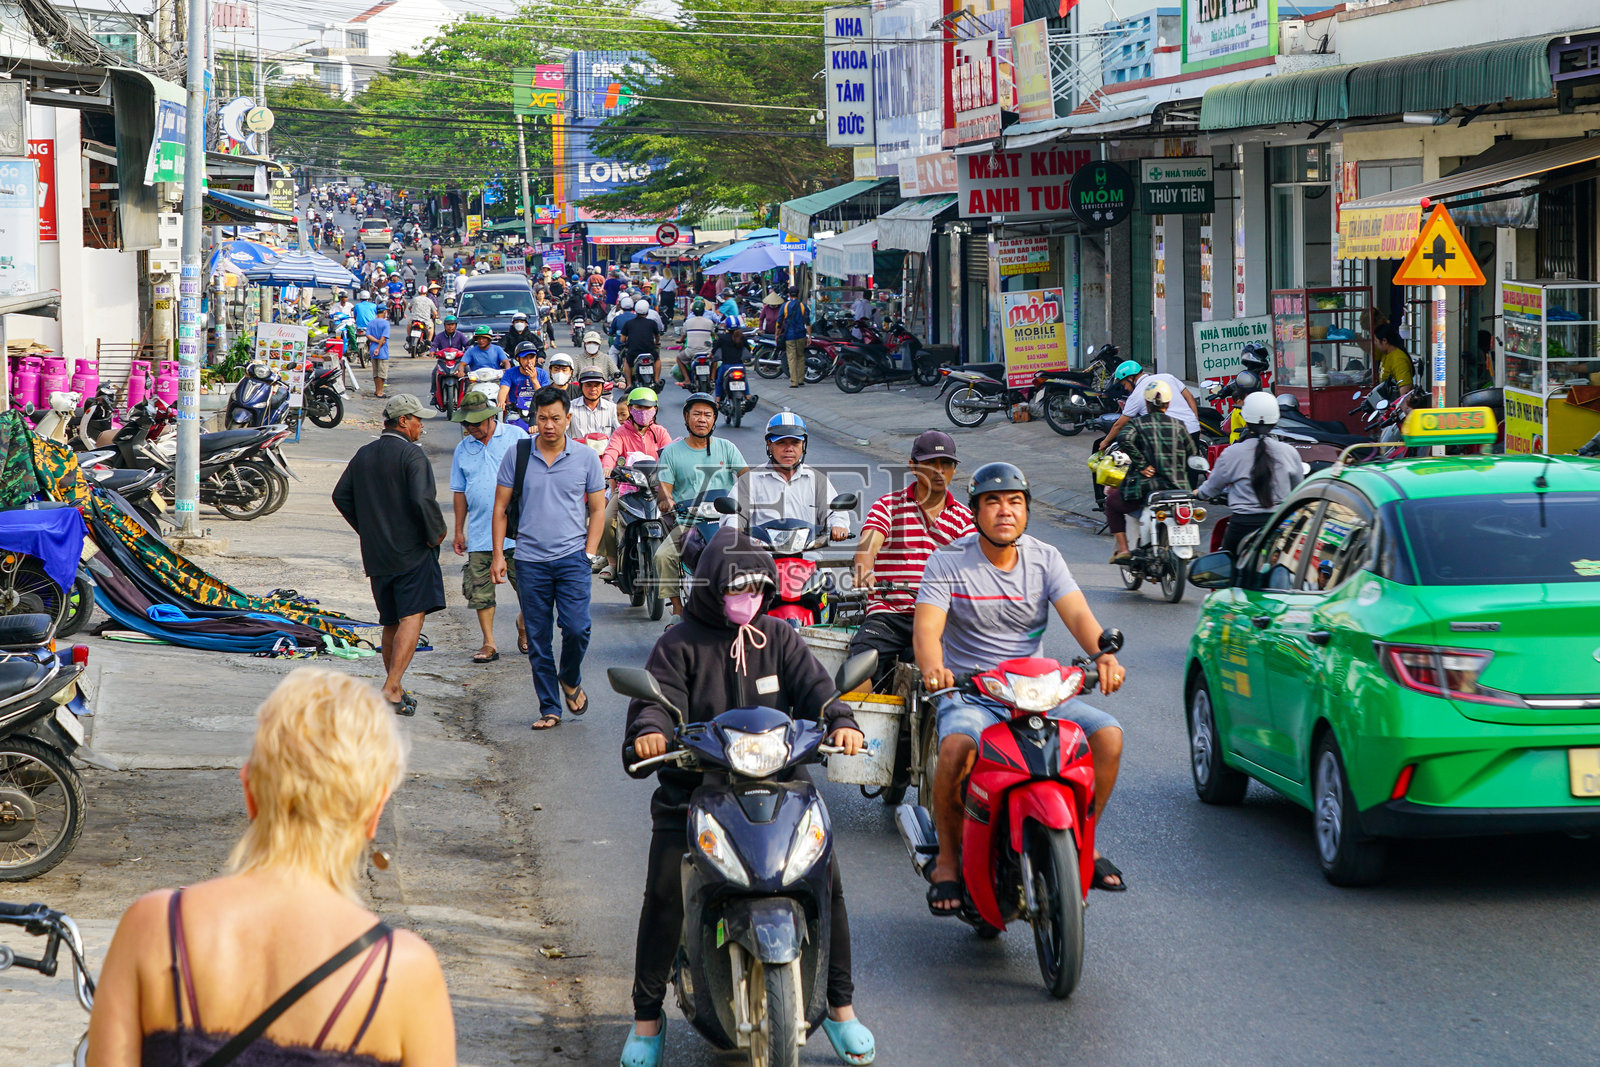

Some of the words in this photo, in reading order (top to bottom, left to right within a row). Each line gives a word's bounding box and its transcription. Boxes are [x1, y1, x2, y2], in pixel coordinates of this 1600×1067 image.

[835, 18, 863, 37] NHA
[832, 50, 868, 70] KHOA
[836, 79, 865, 102] TÂM
[838, 111, 865, 135] ĐỨC
[1031, 146, 1091, 176] KÍNH
[1165, 168, 1181, 178] NHÀ
[1182, 167, 1206, 177] THUỐC
[969, 188, 1020, 214] ANH
[1149, 185, 1178, 203] THÙY
[1180, 185, 1205, 203] TIÊN
[1381, 235, 1397, 252] BÚN
[1014, 326, 1055, 337] MOBILE
[1201, 327, 1219, 340] NHÀ
[1221, 323, 1250, 338] THUỐC
[1252, 322, 1267, 335] TÂY
[1203, 355, 1271, 371] фарм
[1437, 413, 1484, 429] 1055
